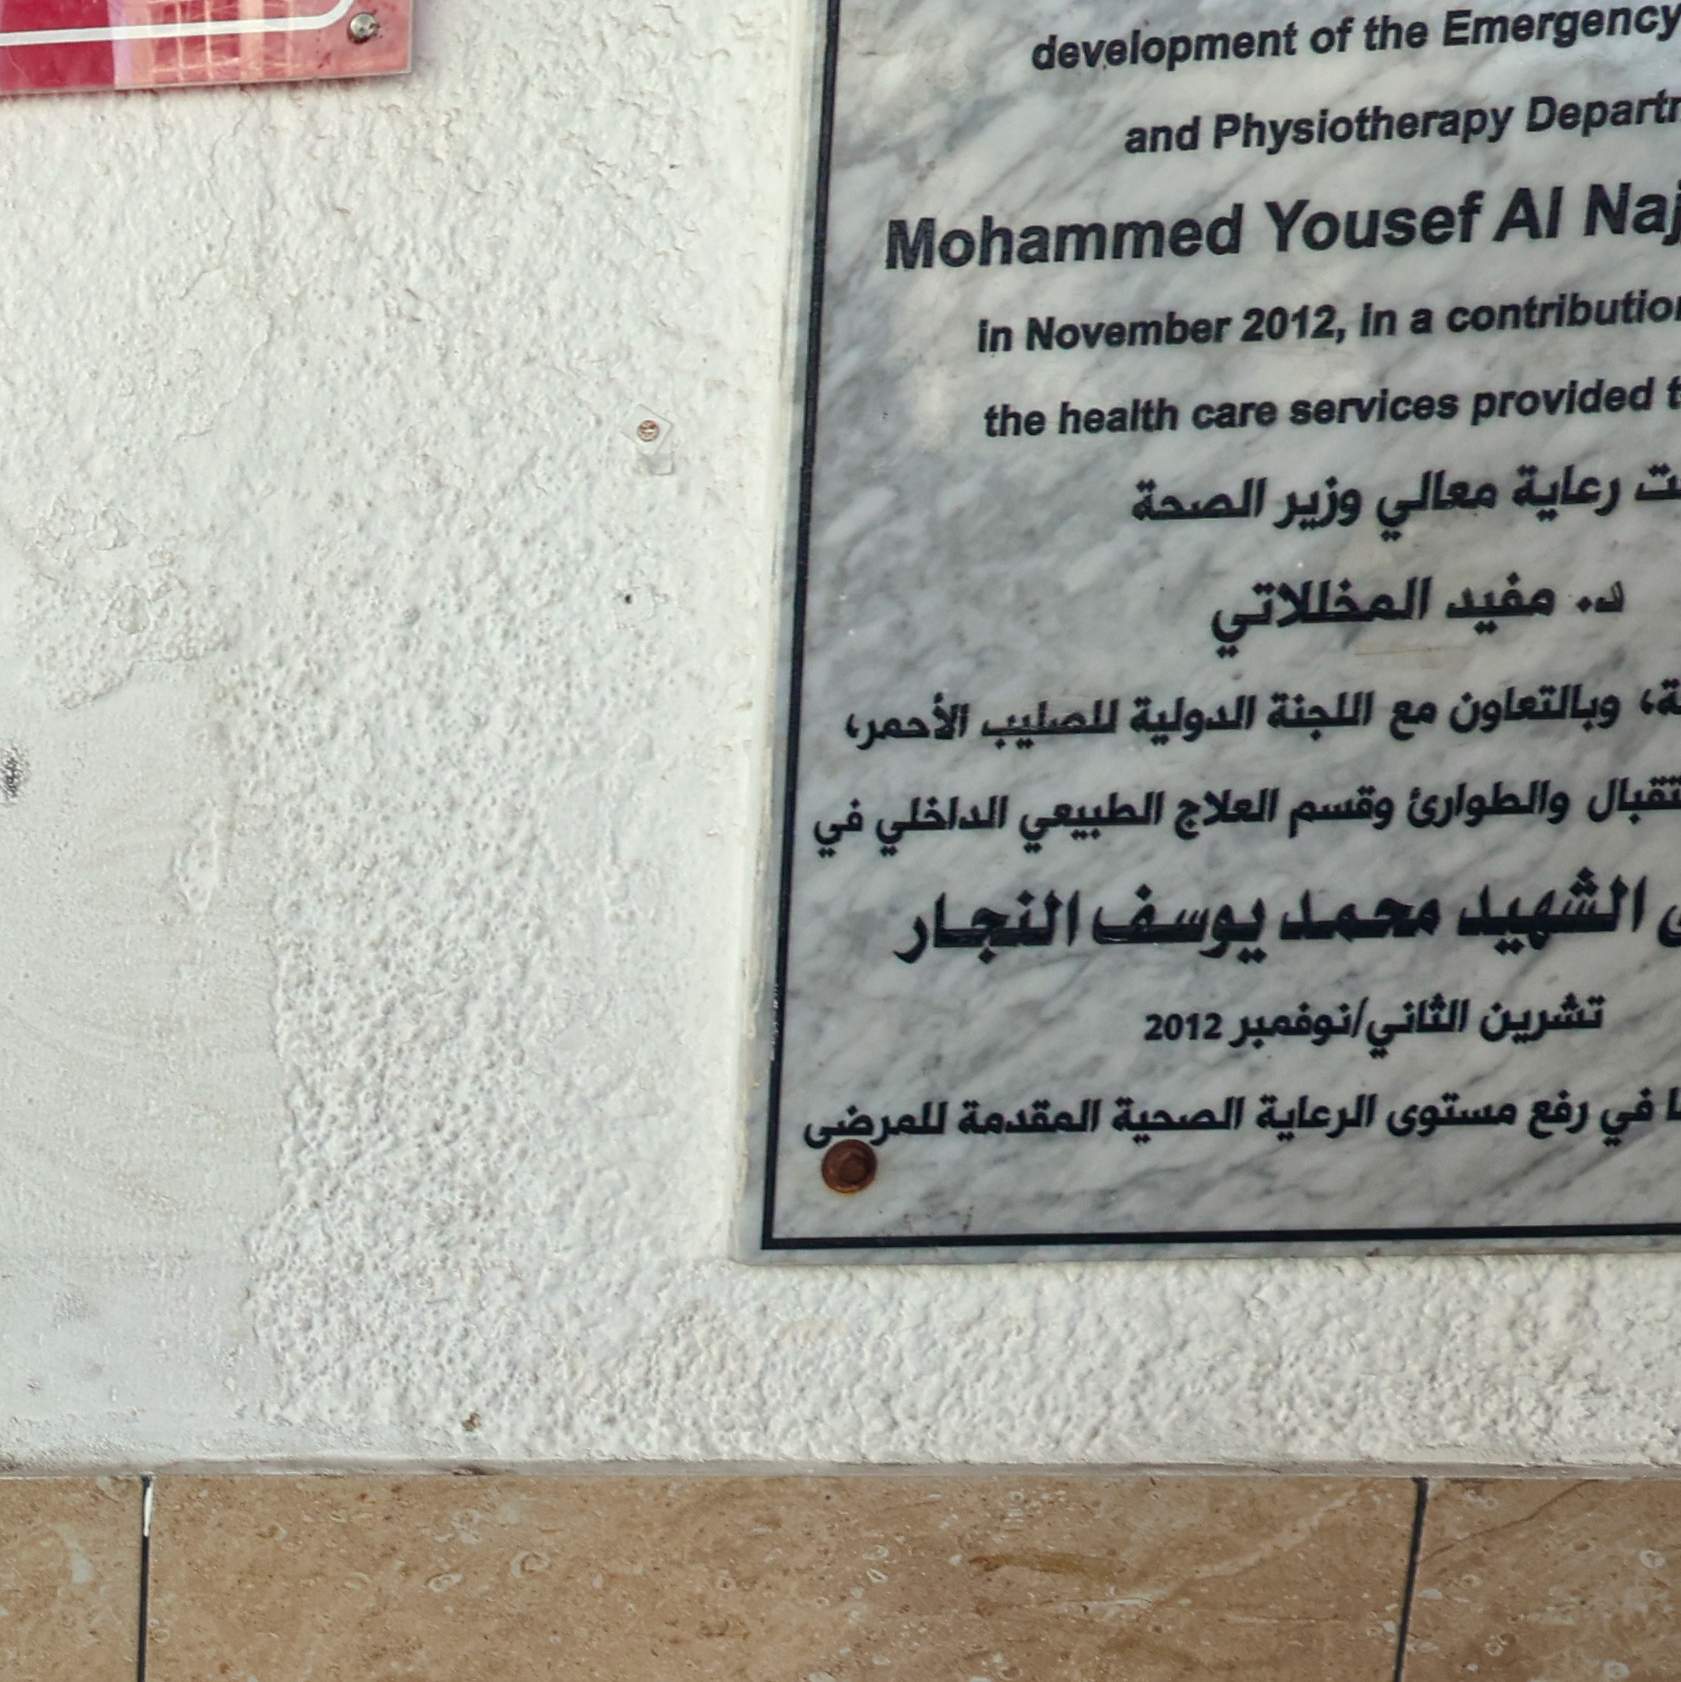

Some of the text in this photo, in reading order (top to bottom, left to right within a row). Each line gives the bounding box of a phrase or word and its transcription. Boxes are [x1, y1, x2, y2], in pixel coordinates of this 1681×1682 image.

[1031, 2, 1681, 71] development of the Emergency
[1124, 115, 1202, 155] and
[1213, 104, 1516, 156] Physiotherapy
[884, 202, 1245, 271] Mohammed
[1263, 188, 1486, 253] Yousef
[1492, 184, 1566, 243] Al
[977, 288, 1681, 354] in November 2012, in a contributio
[983, 402, 1047, 438] the
[1058, 397, 1180, 434] health
[1191, 400, 1278, 430] care
[1289, 387, 1460, 425] services
[1470, 375, 1657, 426] provided
[1131, 476, 1269, 522] الصحة
[1272, 475, 1363, 530] وزير
[1375, 468, 1499, 543] معالي
[1511, 463, 1622, 523] رعاية
[1210, 575, 1433, 659] المخللاتي
[1445, 571, 1557, 636] مفيد
[981, 697, 1120, 751] للصليب
[1129, 695, 1258, 746] الدولية
[1266, 689, 1377, 743] اللجنة
[1389, 699, 1438, 742] مع
[1449, 683, 1622, 733] وبالتعاون
[813, 797, 865, 859] في
[874, 794, 1011, 858] الداخلي
[1018, 789, 1168, 854] الطبيعي
[1174, 786, 1280, 841] العلاج
[1287, 784, 1396, 840] وقسم
[1407, 779, 1571, 829] والطوارئ
[892, 888, 1082, 965] النجار
[1091, 882, 1269, 965] يوسف
[1279, 888, 1441, 943] محمد
[1457, 865, 1648, 956] الشهيد
[1143, 1011, 1223, 1042] 2012
[1479, 991, 1607, 1045] تشرين
[803, 1100, 950, 1150] للمرضى
[957, 1097, 1104, 1136] المقدمة
[1109, 1095, 1247, 1147] الصحية
[1256, 1092, 1379, 1143] الرعاية
[1387, 1091, 1519, 1138] مستوى
[1528, 1089, 1590, 1140] رفع
[1600, 1086, 1655, 1148] في
